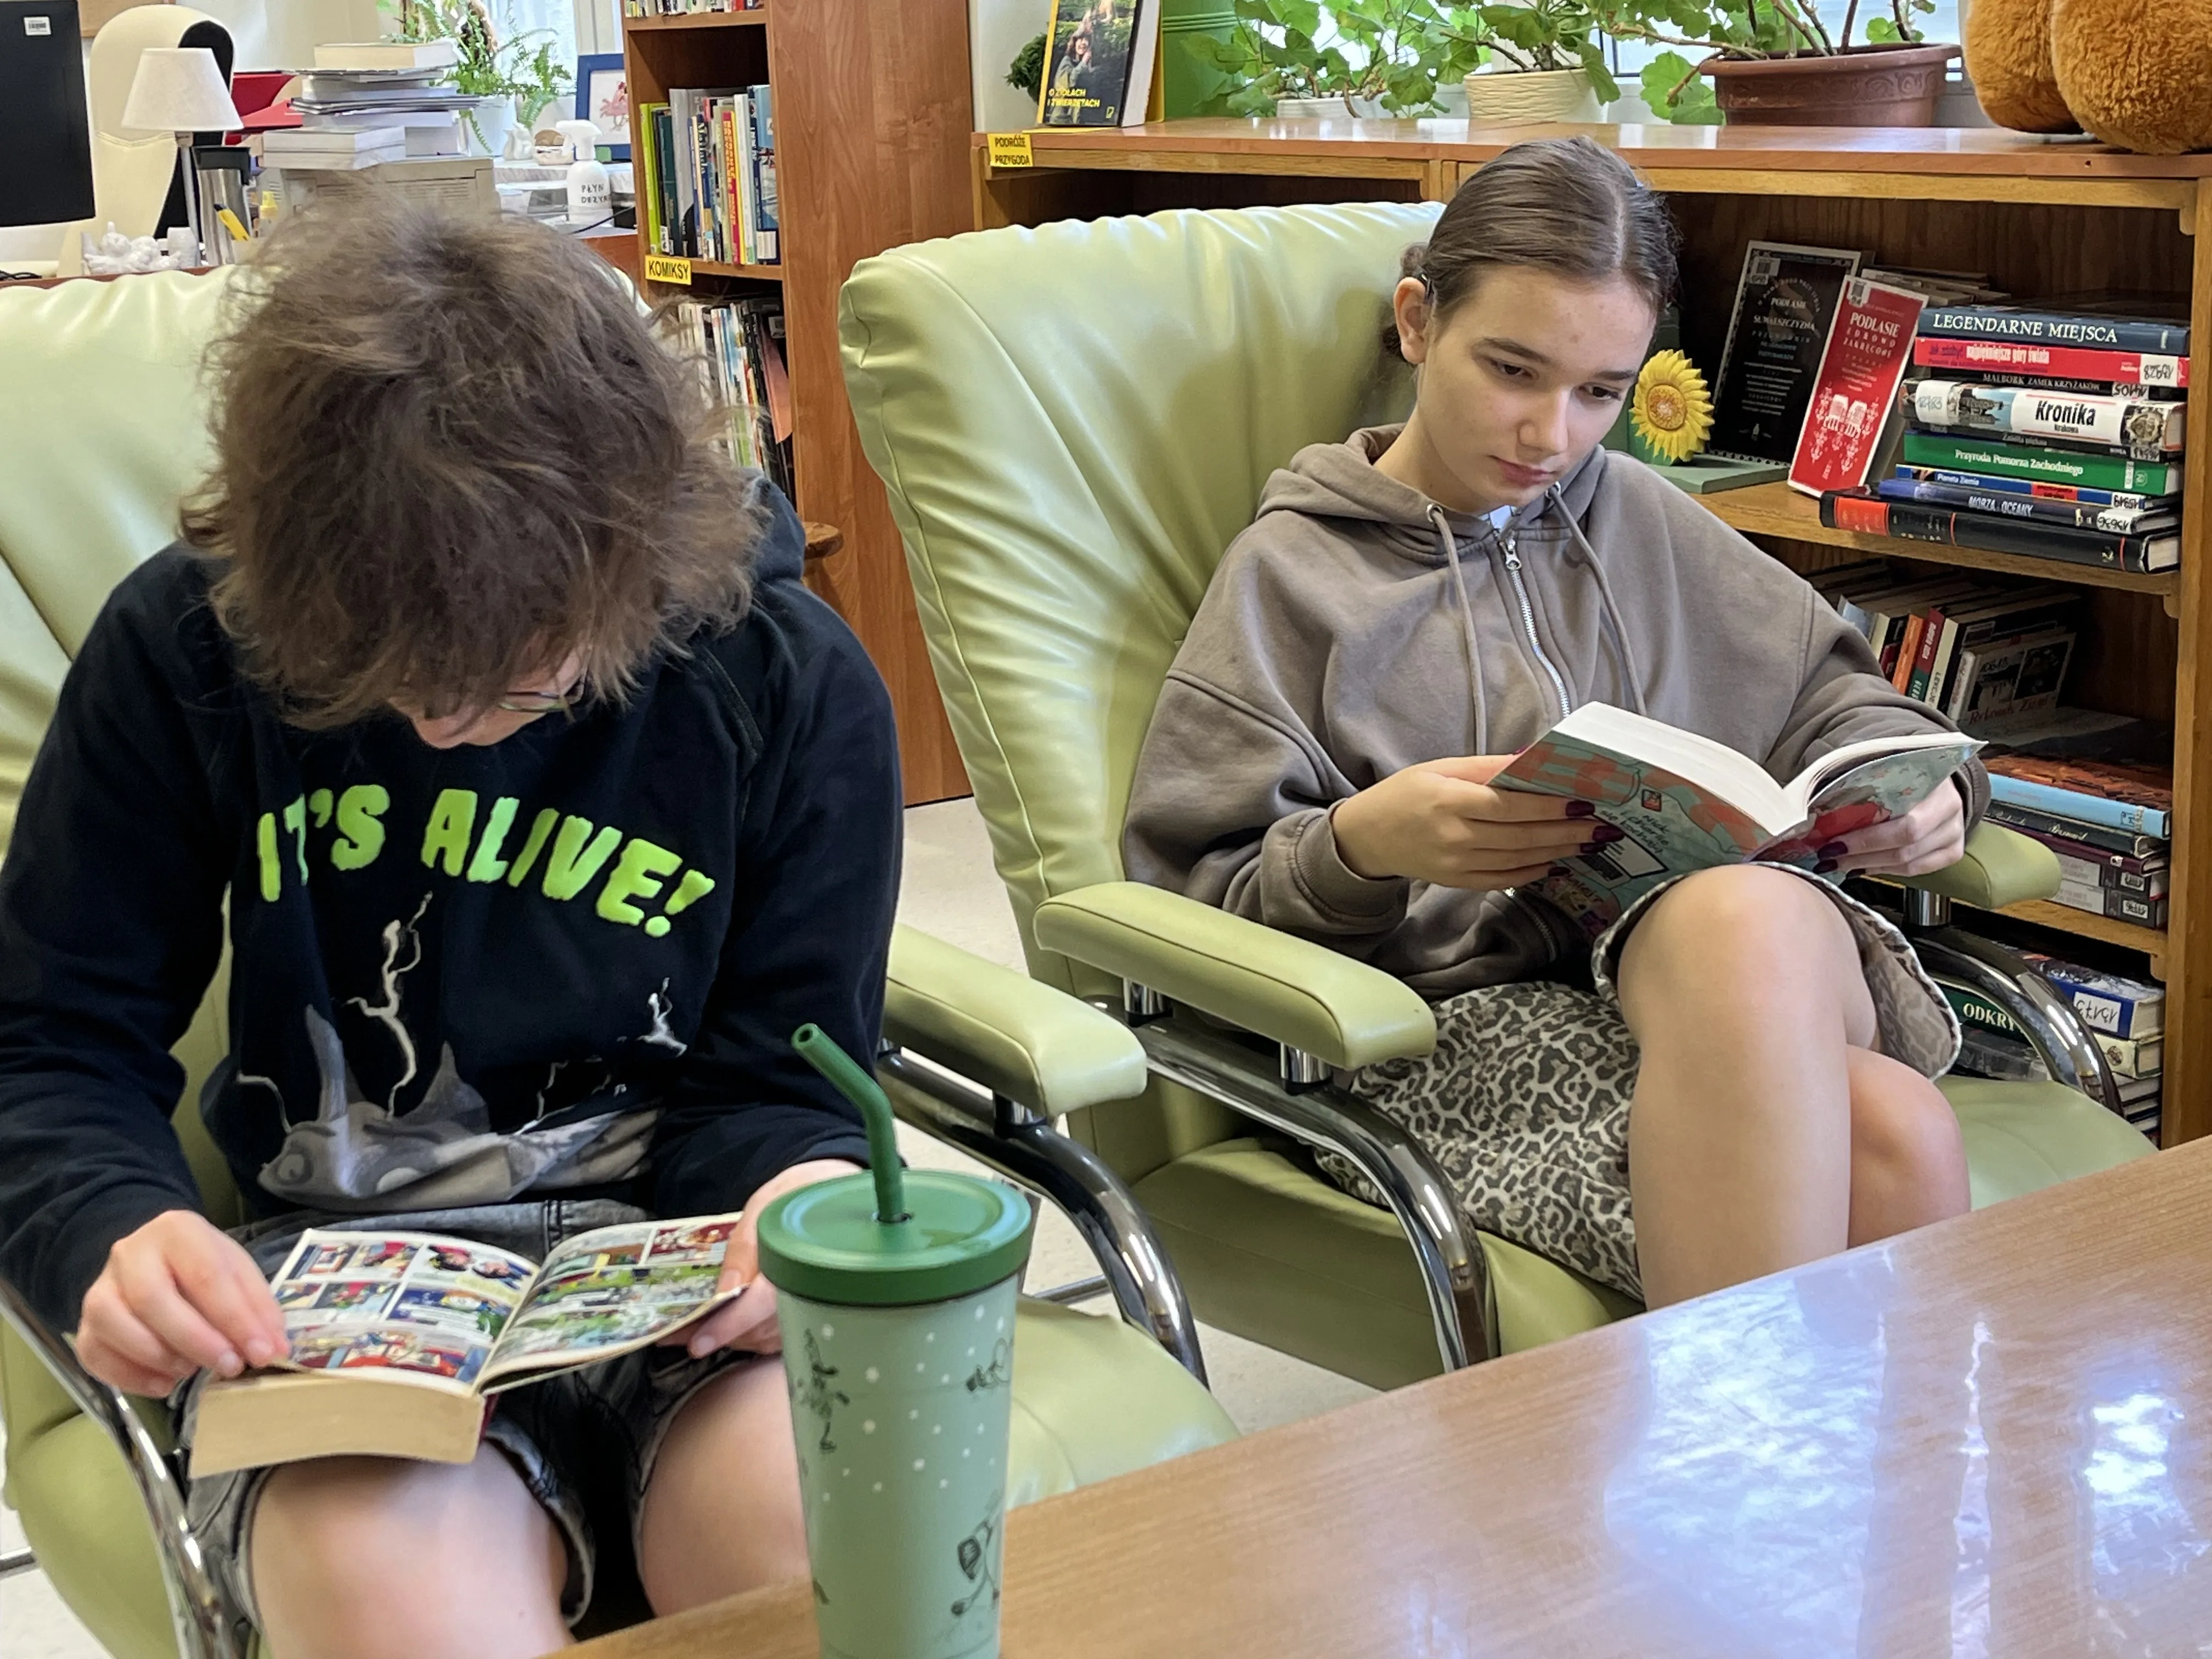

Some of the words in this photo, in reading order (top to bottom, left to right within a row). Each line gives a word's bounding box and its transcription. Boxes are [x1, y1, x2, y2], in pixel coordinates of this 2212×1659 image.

[995, 134, 1026, 148] PODRÓŻE
[995, 155, 1031, 165] PRZYGODA
[581, 183, 604, 193] PŁYN
[648, 260, 689, 280] KOMIKSY
[1849, 312, 1901, 338] PODLASIE
[1933, 313, 2042, 336] LEGENDARNE
[2049, 323, 2118, 343] MIEJSCA
[1983, 373, 2025, 385] MALBORK
[2035, 400, 2097, 426] Kronika
[1955, 449, 1991, 462] Przyroda
[1993, 454, 2029, 468] Pomorza
[2030, 458, 2084, 477] Zachodniego
[1968, 496, 1996, 511] MORZA
[2001, 500, 2034, 517] OCEANY
[1641, 815, 1669, 834] Nick
[256, 784, 390, 902] IT'S
[420, 788, 715, 938] ALIVE!
[1963, 1003, 2018, 1032] ODKRY
